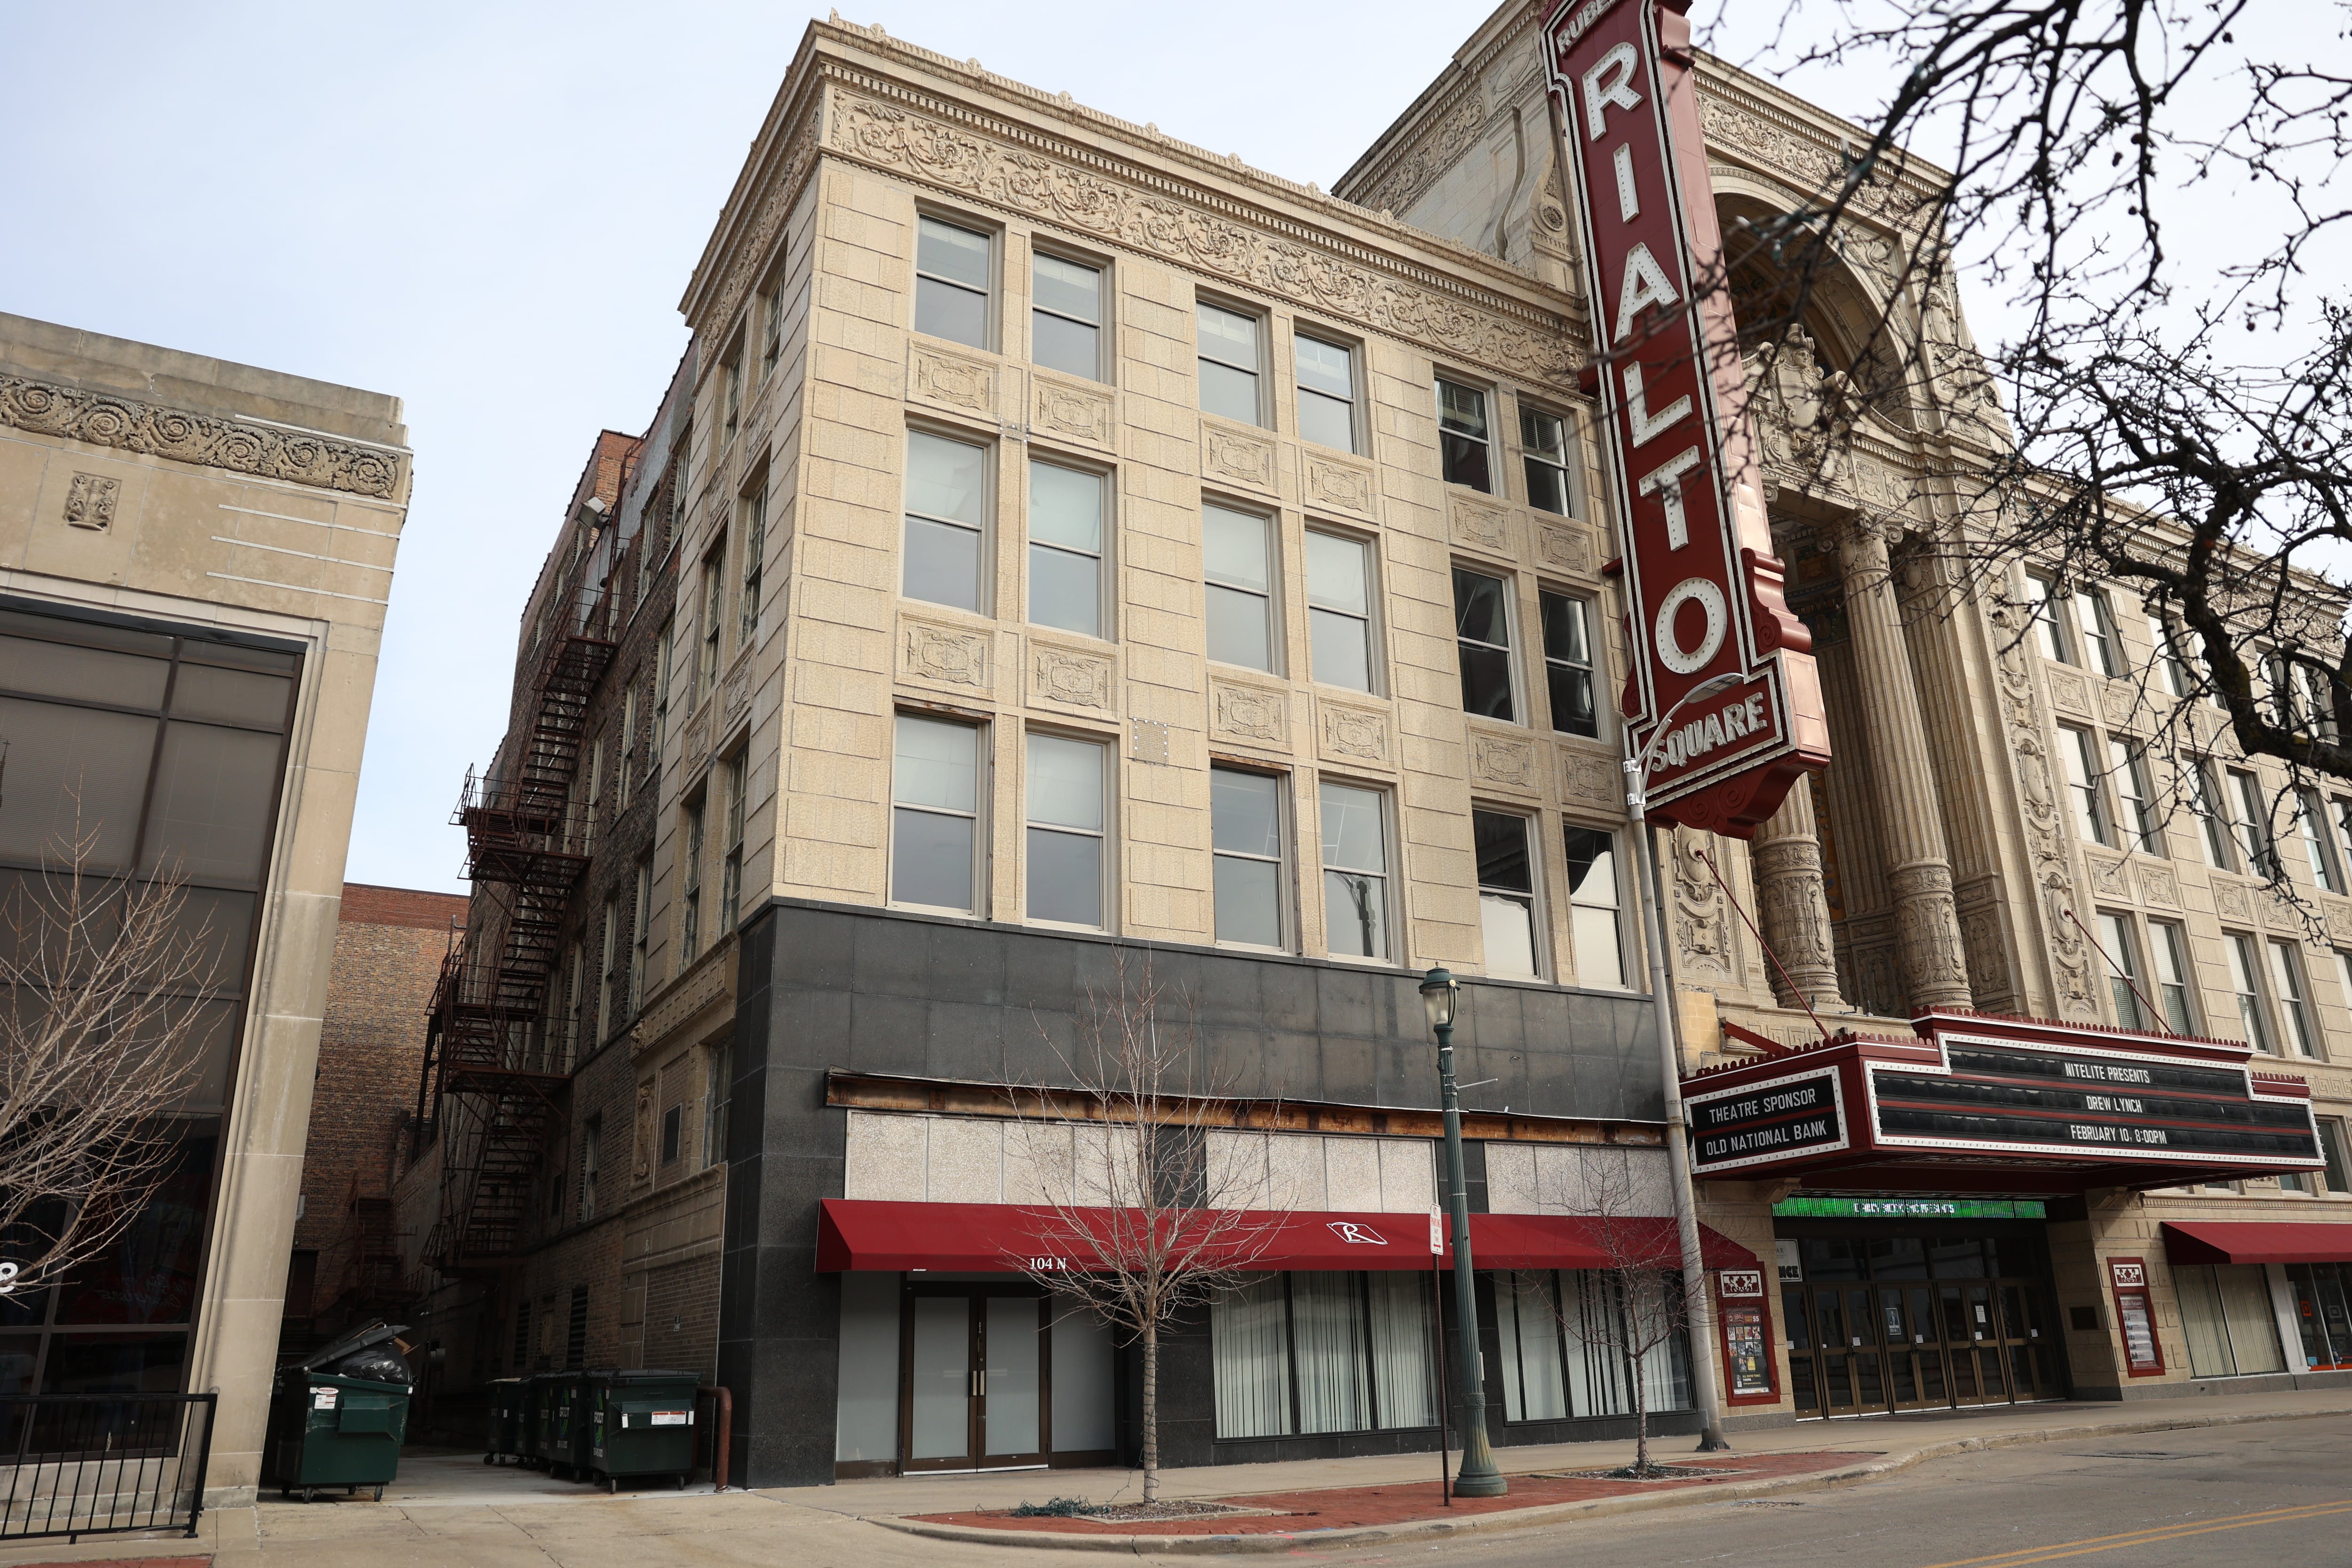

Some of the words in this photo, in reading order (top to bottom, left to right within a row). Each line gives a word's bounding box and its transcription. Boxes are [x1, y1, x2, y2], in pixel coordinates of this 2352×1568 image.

[1581, 41, 1728, 674] RIALTO
[1651, 692, 1768, 772] SQUARE
[2065, 1063, 2106, 1079] NITELITE
[2107, 1067, 2150, 1083] PRESENTS
[1709, 1100, 1759, 1123] THEATRE
[1764, 1088, 1817, 1112] SPONSOR
[2086, 1096, 2111, 1110] DREW
[2113, 1098, 2142, 1113] LYNCH
[1706, 1139, 1727, 1156] OLD
[1731, 1127, 1790, 1151] NATIONAL
[1793, 1120, 1827, 1140] BANK
[2070, 1125, 2116, 1141] FEBRUARY
[2119, 1128, 2133, 1142] 10,
[2135, 1129, 2167, 1144] 8:00PM
[1433, 1206, 1438, 1217] NO
[1430, 1217, 1441, 1228] PARKING
[1030, 1257, 1053, 1269] 104
[1057, 1258, 1066, 1269] N
